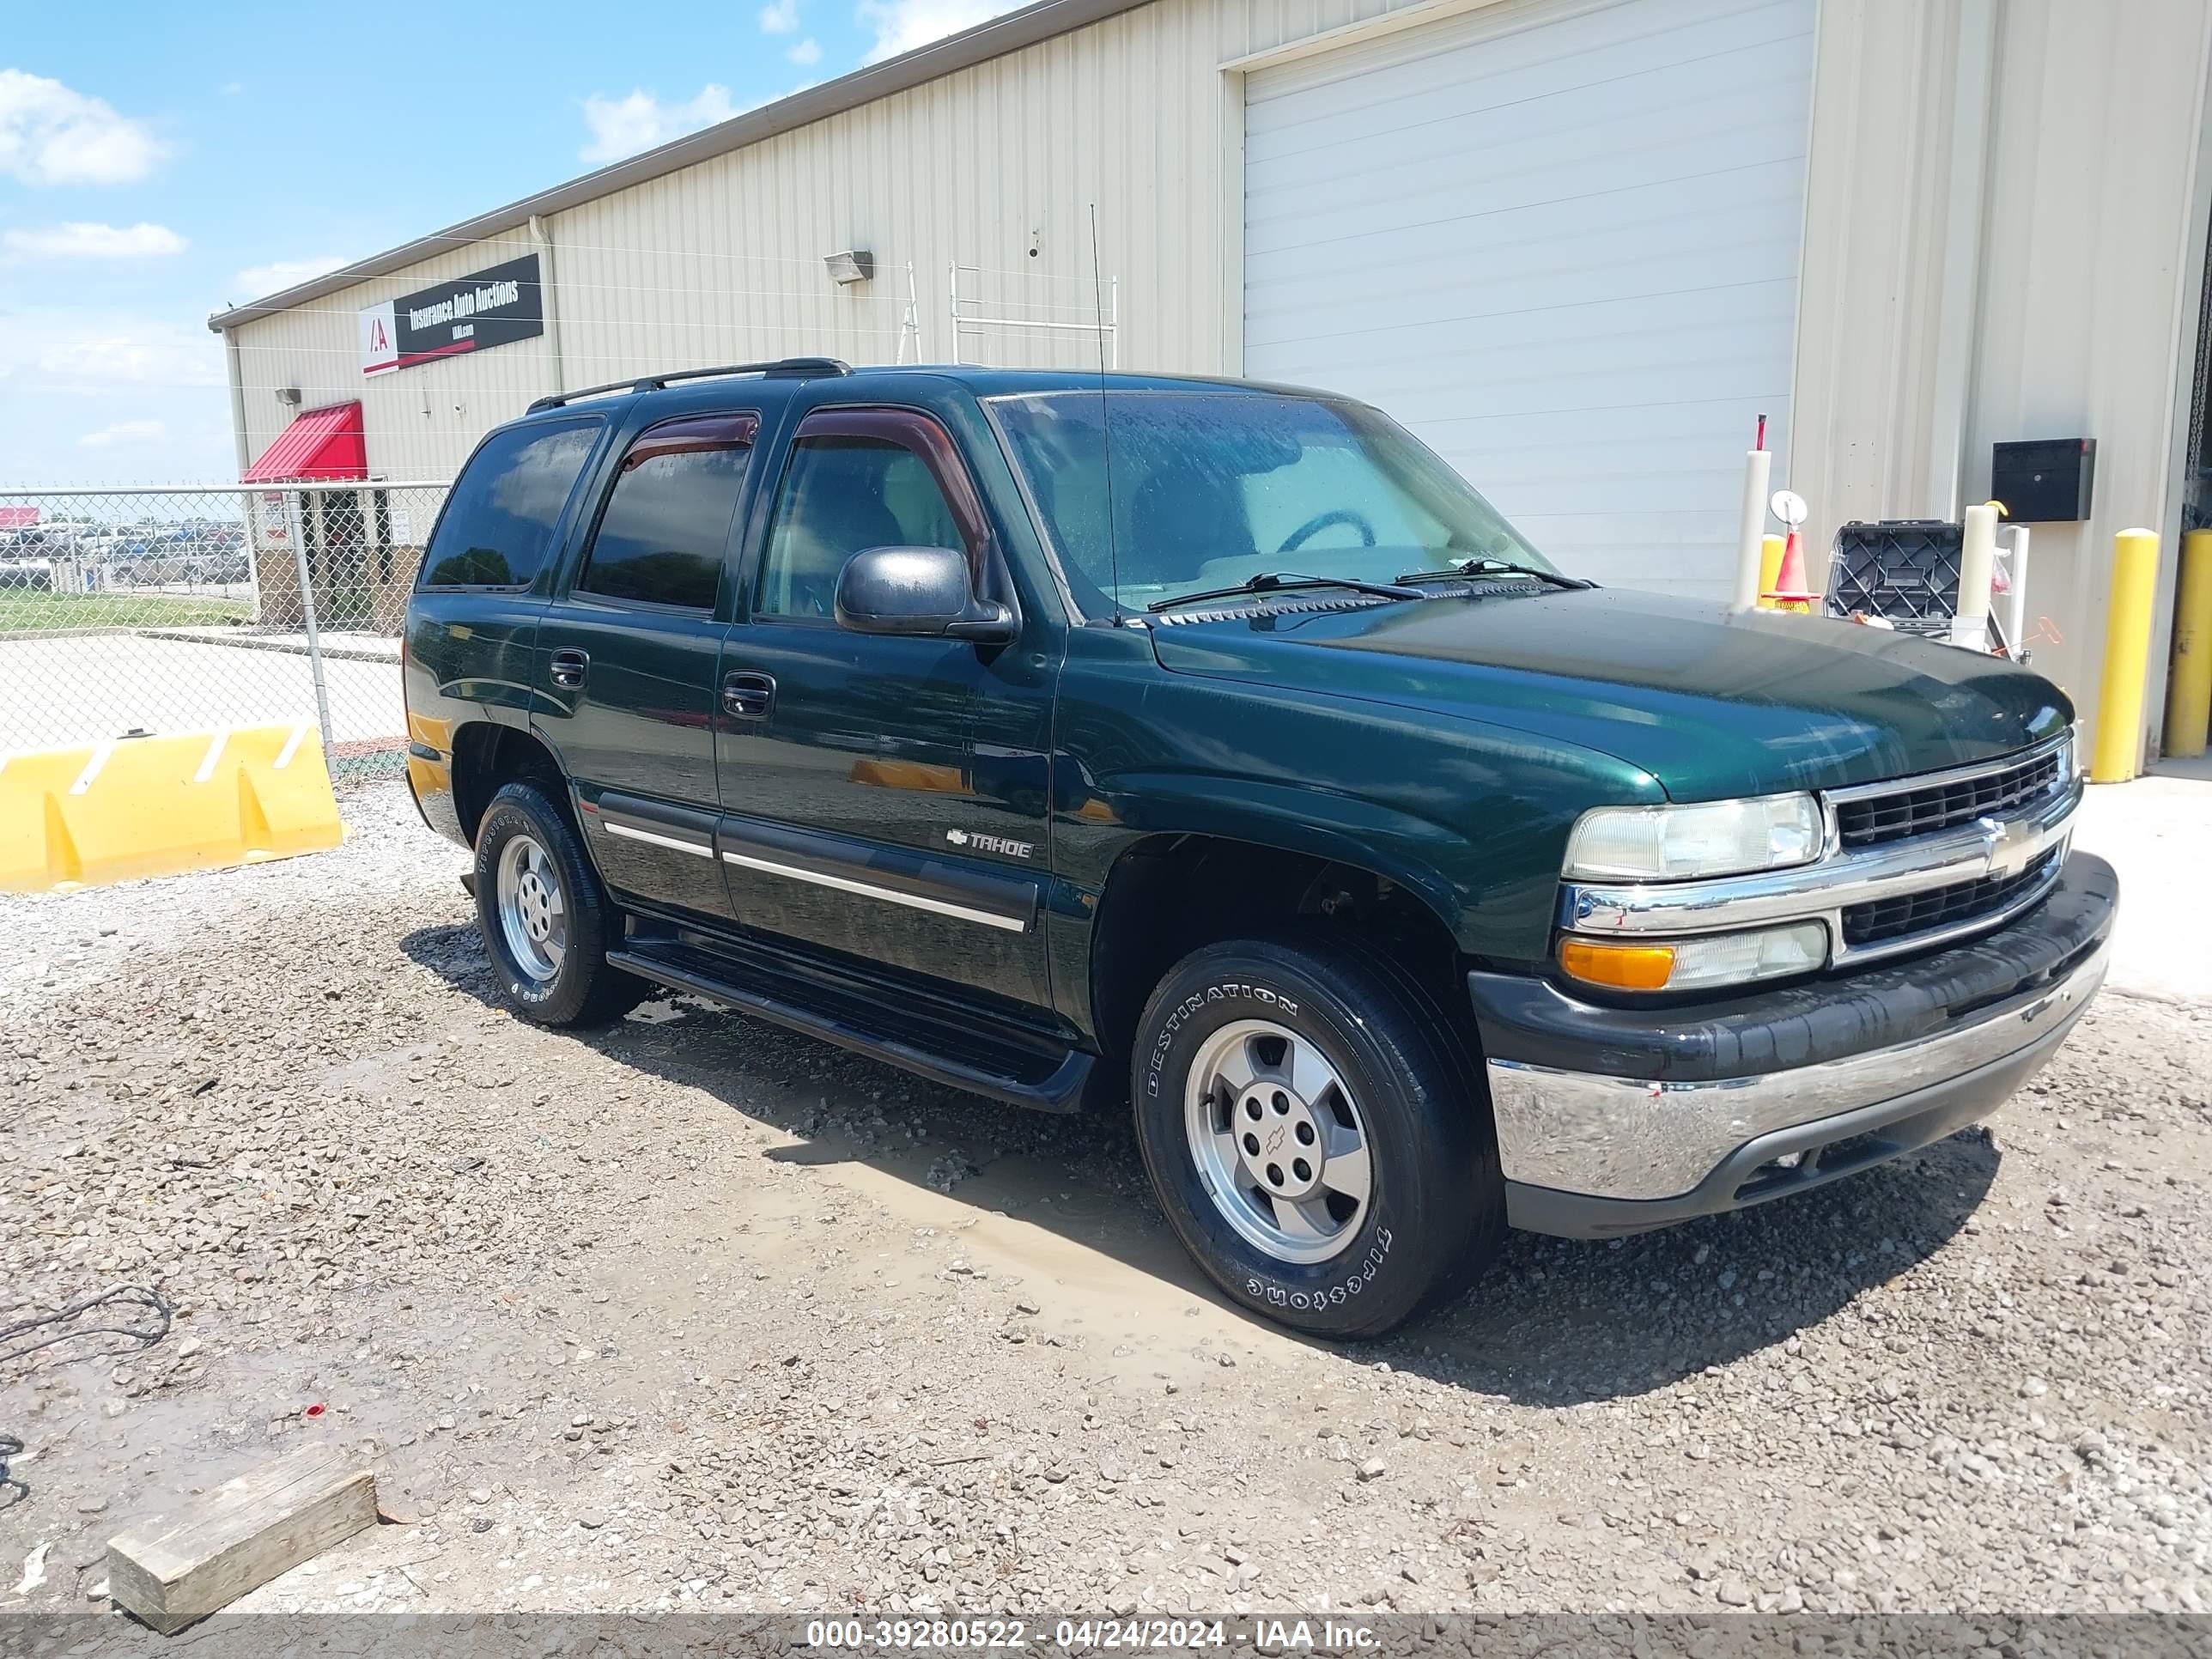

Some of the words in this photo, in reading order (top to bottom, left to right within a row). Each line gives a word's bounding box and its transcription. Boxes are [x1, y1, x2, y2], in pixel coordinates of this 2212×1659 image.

[410, 300, 453, 331] Insurance
[454, 293, 475, 319] Auto
[475, 280, 519, 313] Auctions
[478, 815, 519, 873] Firestone
[970, 834, 1032, 859] TAHOE
[1146, 983, 1298, 1098] DESTINATION
[1246, 1225, 1393, 1311] Firestone
